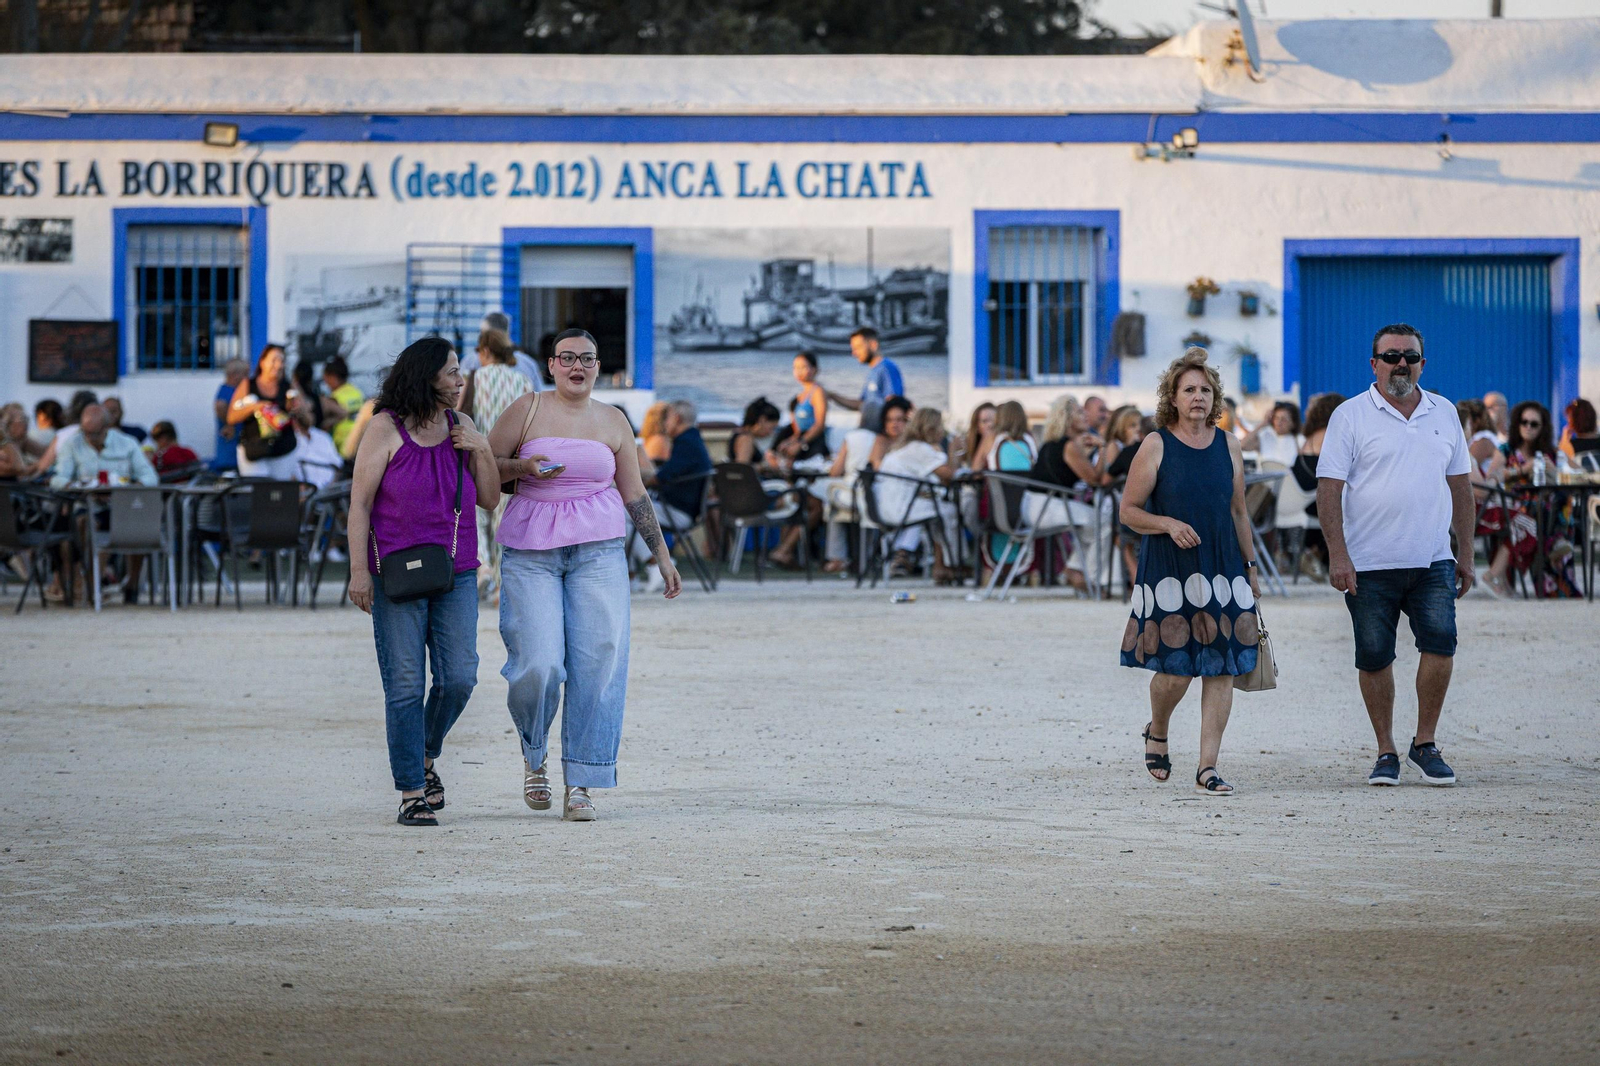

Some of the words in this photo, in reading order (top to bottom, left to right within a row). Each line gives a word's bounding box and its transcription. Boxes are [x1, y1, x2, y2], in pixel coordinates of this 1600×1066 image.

[56, 160, 105, 197] LA
[121, 159, 377, 207] BORRIQUERA
[390, 154, 497, 201] (desde
[508, 155, 601, 202] 2.012)
[614, 161, 723, 198] ANCA
[737, 162, 787, 198] LA
[795, 162, 932, 198] CHATA
